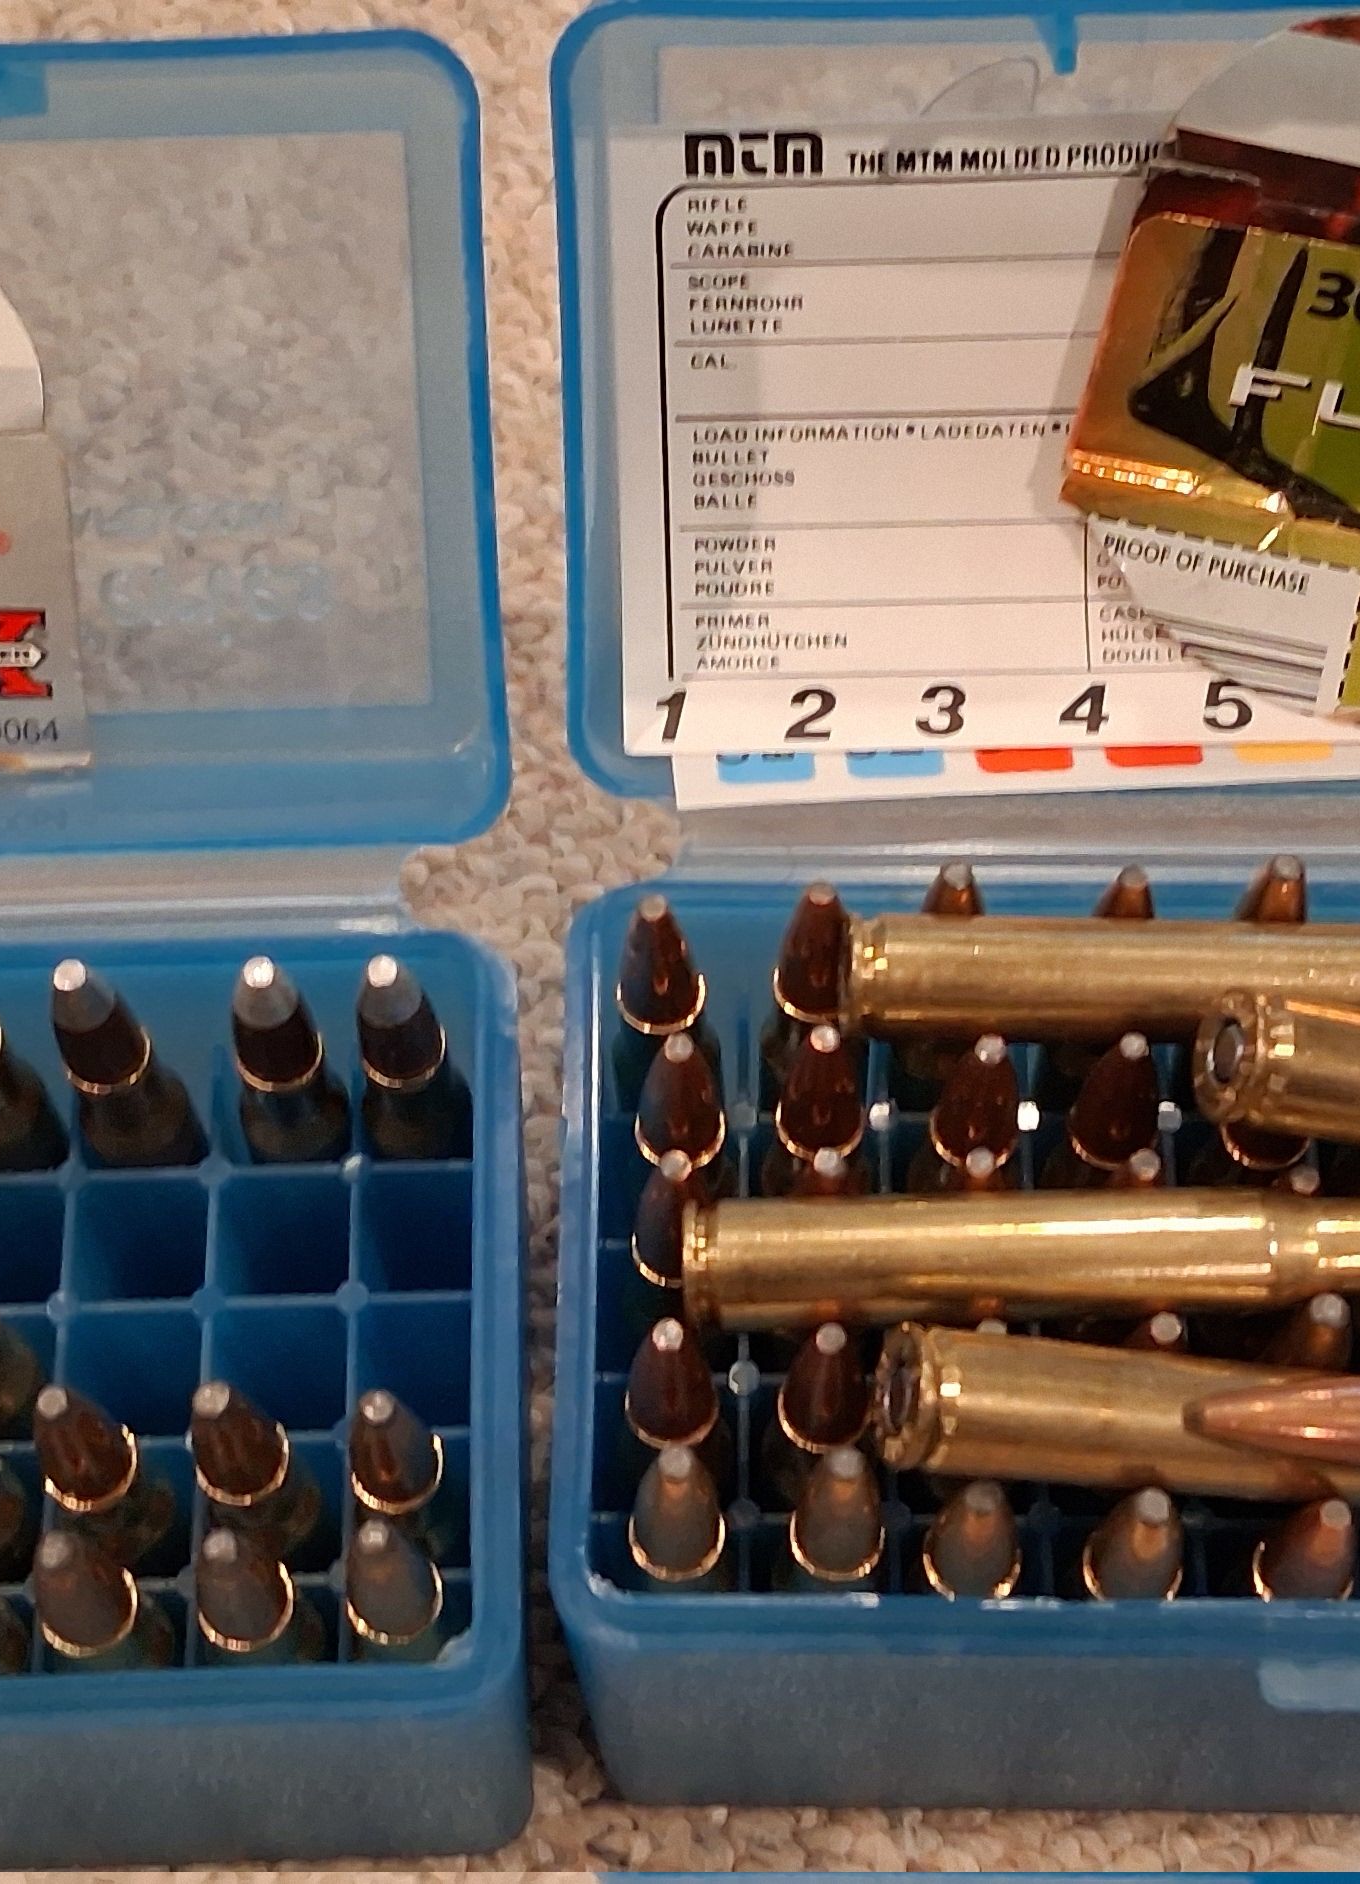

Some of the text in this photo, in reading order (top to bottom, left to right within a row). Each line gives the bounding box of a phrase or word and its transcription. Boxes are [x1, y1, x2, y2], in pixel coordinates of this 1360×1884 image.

[848, 151, 885, 175] THE
[896, 150, 954, 173] MTM
[959, 146, 1061, 172] MOLDED
[688, 198, 747, 214] RIFLE
[687, 219, 758, 237] WAFFE
[687, 241, 793, 259] CARABINE
[688, 272, 750, 290] SCOPE
[689, 293, 803, 312] FERNROHR
[690, 317, 783, 335] LUNETTE
[693, 425, 748, 444] LOAD
[754, 423, 900, 442] INFORMATION
[921, 422, 1046, 440] LADEDATEN
[692, 448, 769, 467] BULLET
[692, 470, 796, 488] GESCHOSS
[693, 491, 758, 511] BALLE
[695, 536, 776, 554] POWDER
[695, 558, 772, 576] PULVER
[1104, 531, 1171, 567] PROOF
[1176, 547, 1205, 573] OF
[1207, 554, 1311, 597] PURCHASE
[695, 580, 775, 598] POUDRE
[696, 612, 770, 630] PRIMER
[697, 653, 780, 671] AMORCE
[656, 688, 688, 744] 1
[784, 684, 838, 741] 2
[914, 683, 968, 738] 3
[1057, 680, 1111, 736] 4
[1201, 679, 1256, 733] 5
